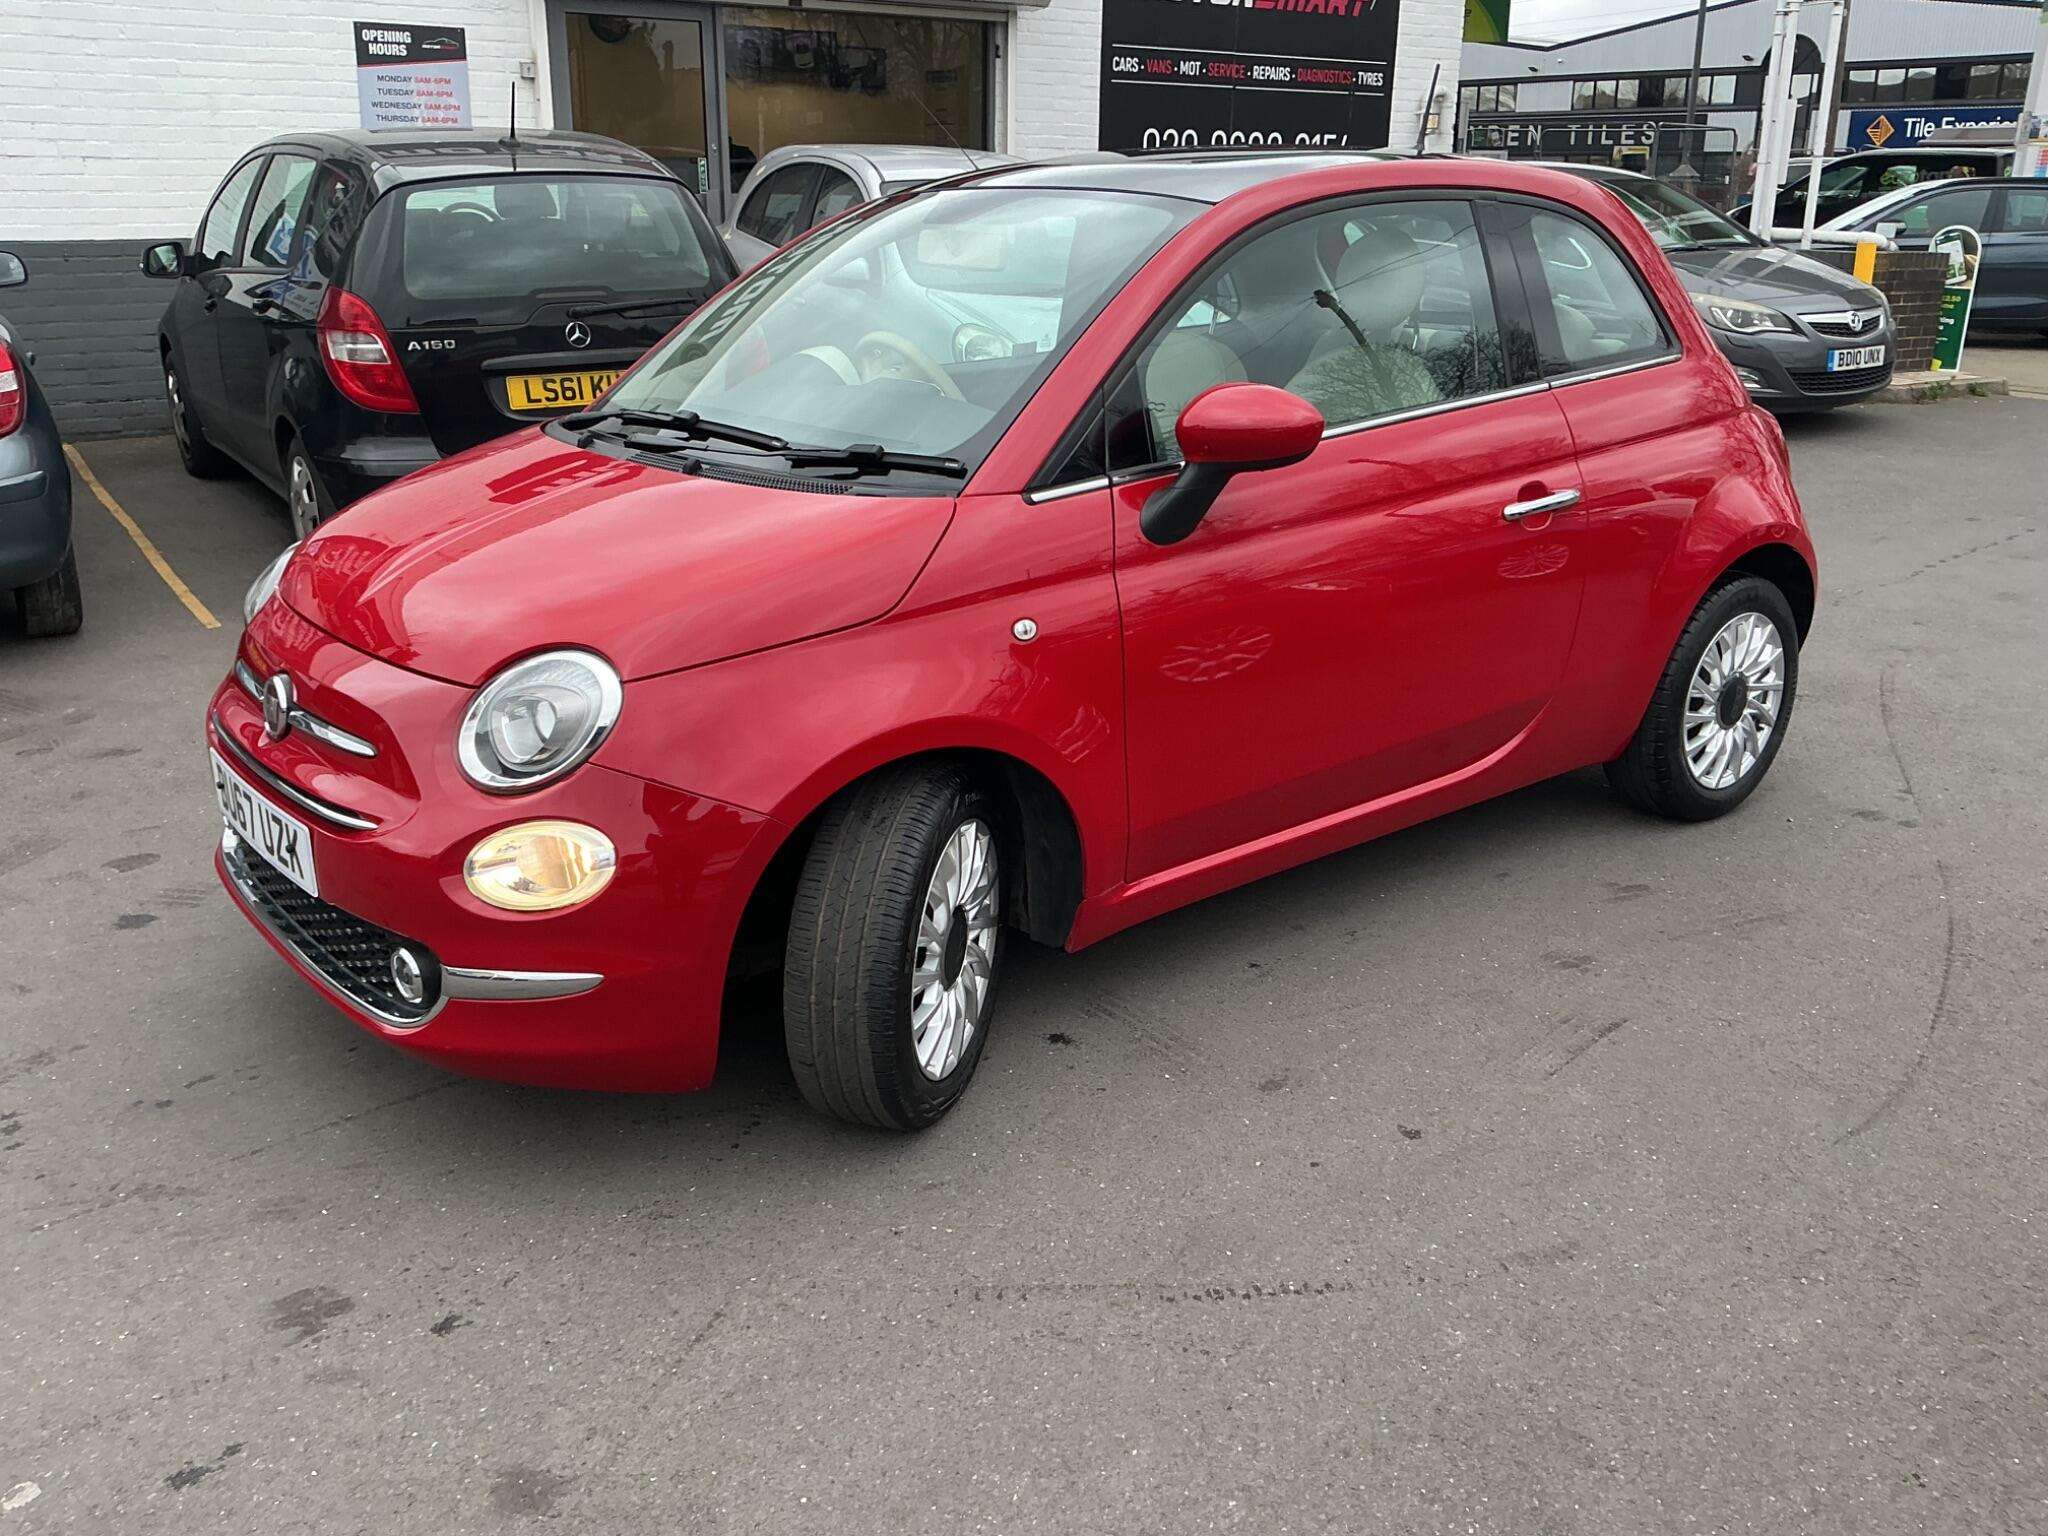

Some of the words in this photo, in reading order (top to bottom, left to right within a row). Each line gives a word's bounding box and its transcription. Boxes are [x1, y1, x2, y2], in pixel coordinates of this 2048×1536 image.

[362, 29, 412, 43] OPENING
[368, 43, 408, 56] HOURS
[1112, 56, 1139, 72] CARS
[1147, 59, 1172, 74] VANS
[1180, 61, 1201, 75] MOT
[1208, 62, 1246, 78] SERVICE
[1253, 65, 1291, 81] REPAIRS
[1297, 68, 1352, 84] DIAGNOSTICS
[1358, 71, 1384, 86] TYRES
[376, 75, 413, 83] MONDAY
[377, 88, 414, 97] TUESDAY
[371, 101, 422, 109] WEDNESDAY
[376, 114, 420, 123] THURSDAY
[1567, 124, 1655, 146] TILES
[1904, 118, 1935, 138] Tile
[407, 340, 456, 351] A160
[1838, 350, 1862, 367] BD10
[1863, 348, 1881, 364] UNX
[523, 376, 584, 403] LS61
[258, 802, 304, 880] UZK
